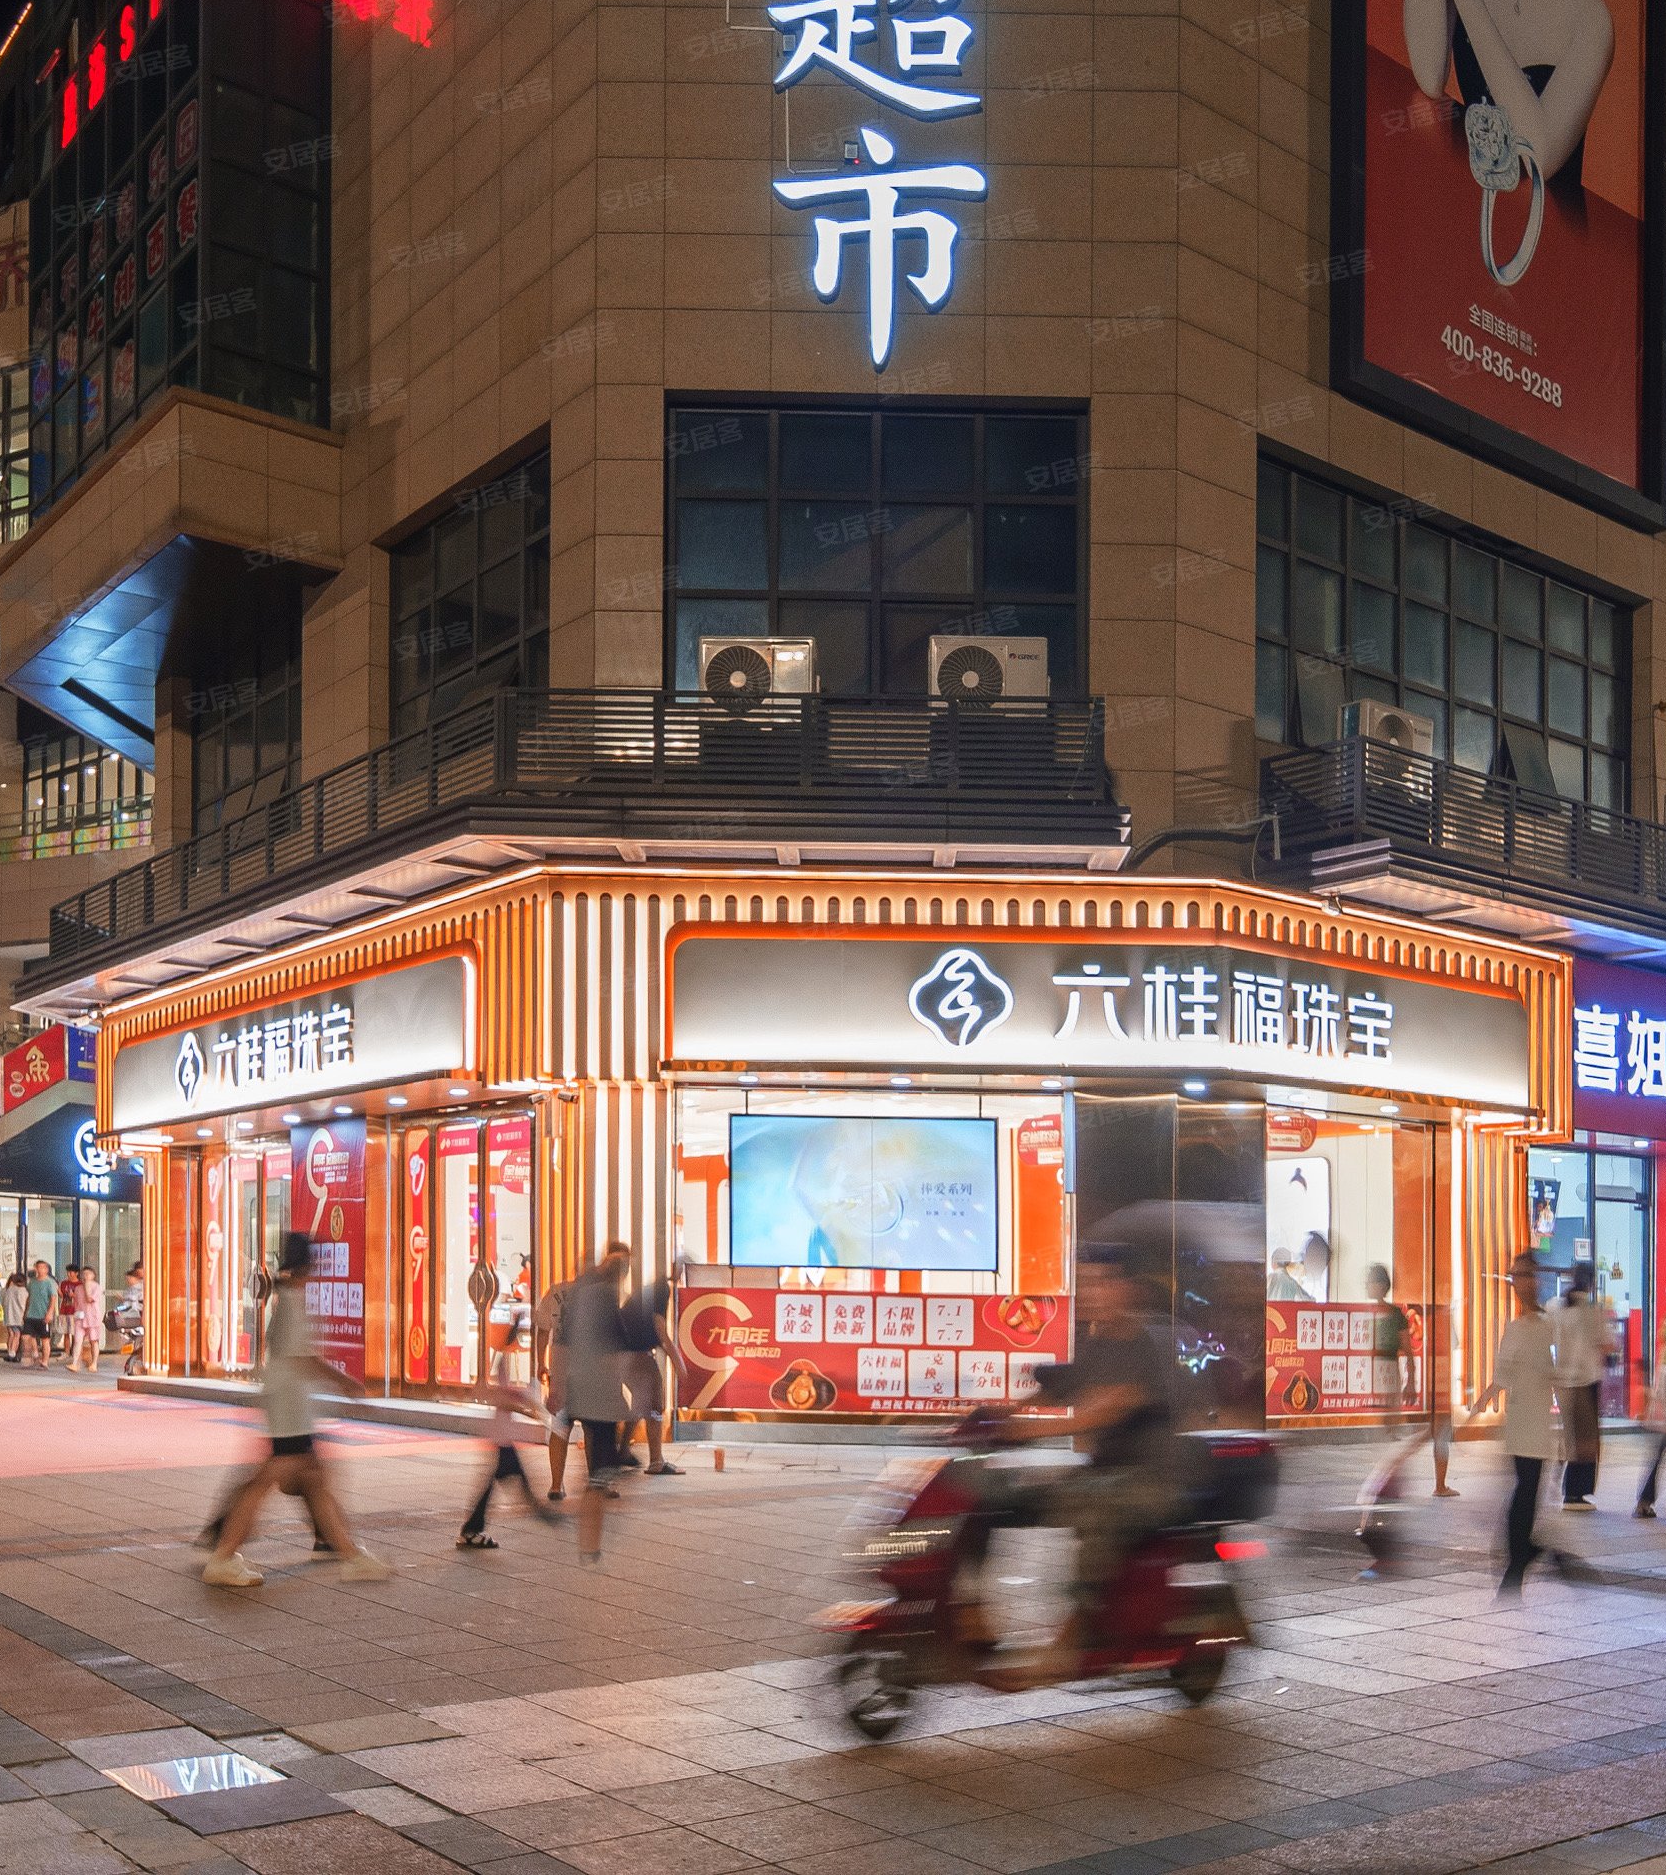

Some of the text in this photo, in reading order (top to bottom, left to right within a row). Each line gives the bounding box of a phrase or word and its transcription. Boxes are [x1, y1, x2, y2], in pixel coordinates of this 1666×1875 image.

[1469, 303, 1519, 348] 全国连锁
[1441, 324, 1562, 408] 400-836-9288
[1053, 963, 1393, 1061] 六桂福珠宝
[213, 1003, 354, 1091] 六桂福珠宝
[782, 1303, 815, 1319] 全城
[833, 1304, 865, 1319] 免费
[884, 1305, 915, 1320] 不限
[936, 1305, 962, 1317] 7.1
[707, 1326, 771, 1345] 九周年
[782, 1320, 815, 1335] 黄金
[833, 1320, 866, 1336] 换新
[883, 1321, 915, 1337] 品牌
[936, 1329, 964, 1342] 7.7
[918, 1353, 944, 1366] 一克
[860, 1379, 901, 1392] 品牌日
